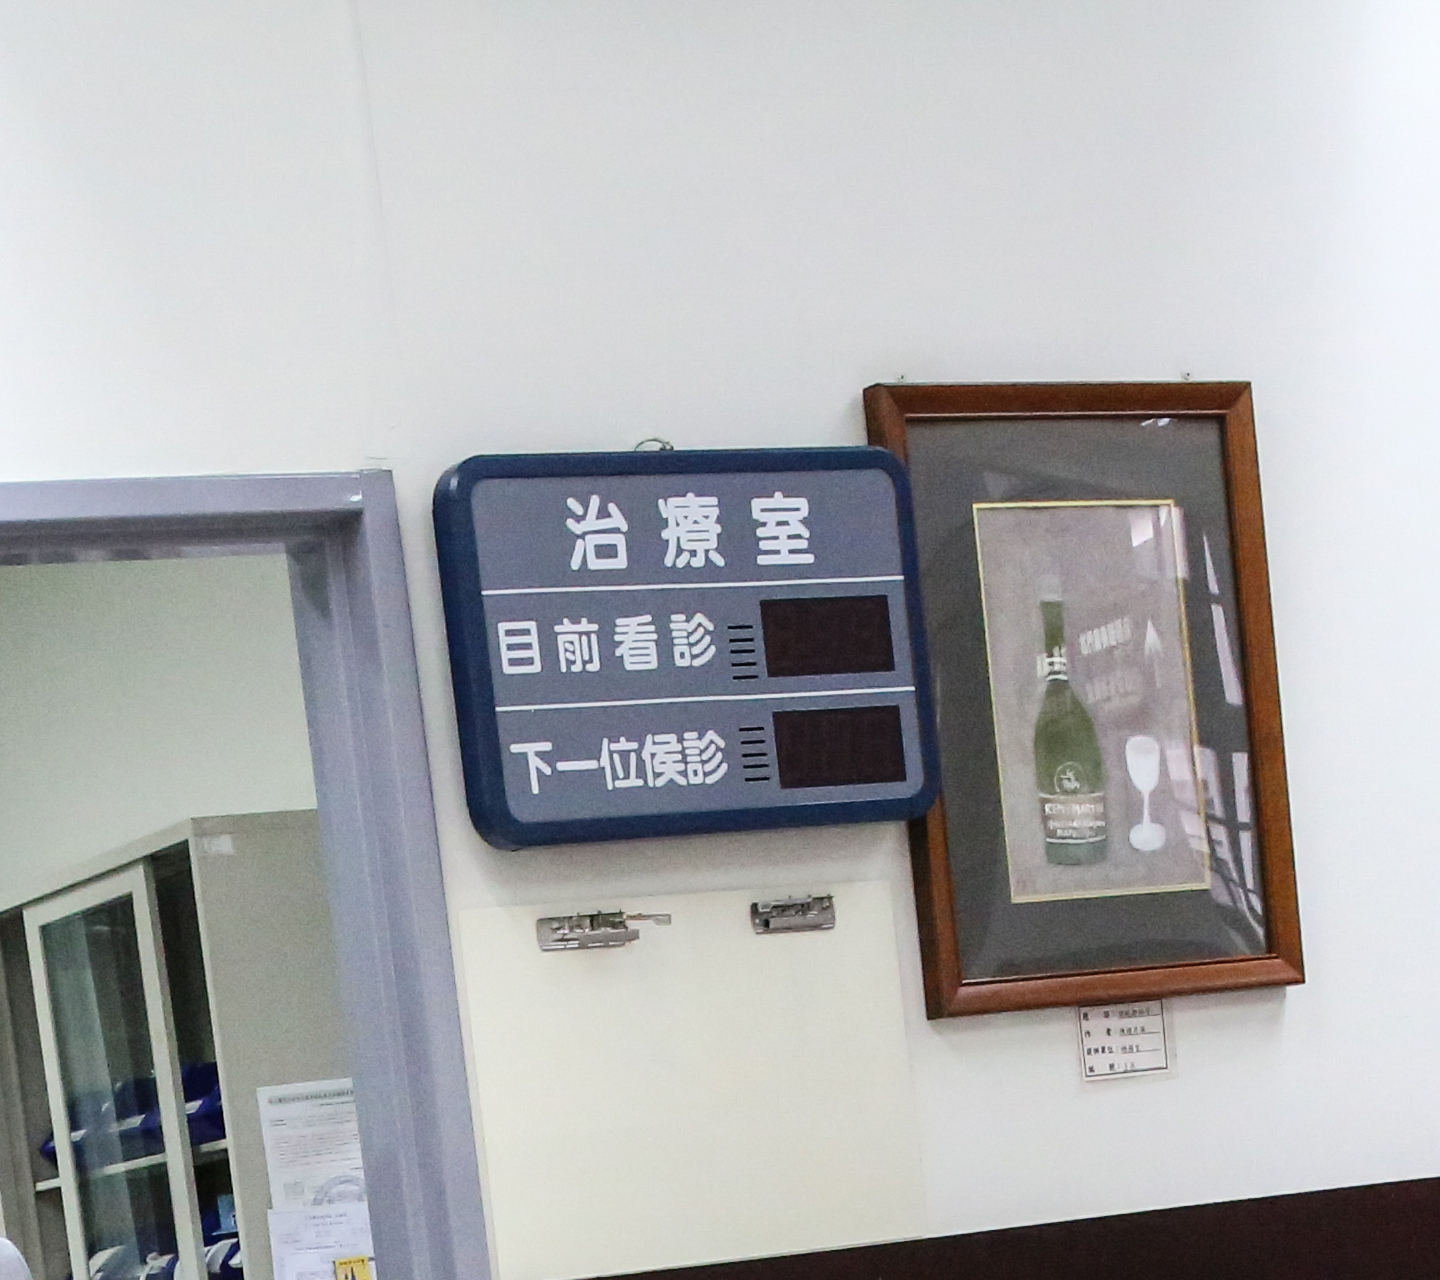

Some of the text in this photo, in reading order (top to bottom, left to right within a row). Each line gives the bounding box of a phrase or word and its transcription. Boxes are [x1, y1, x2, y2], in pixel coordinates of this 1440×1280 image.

[565, 491, 816, 571] 治療室
[497, 612, 717, 675] 目前看診
